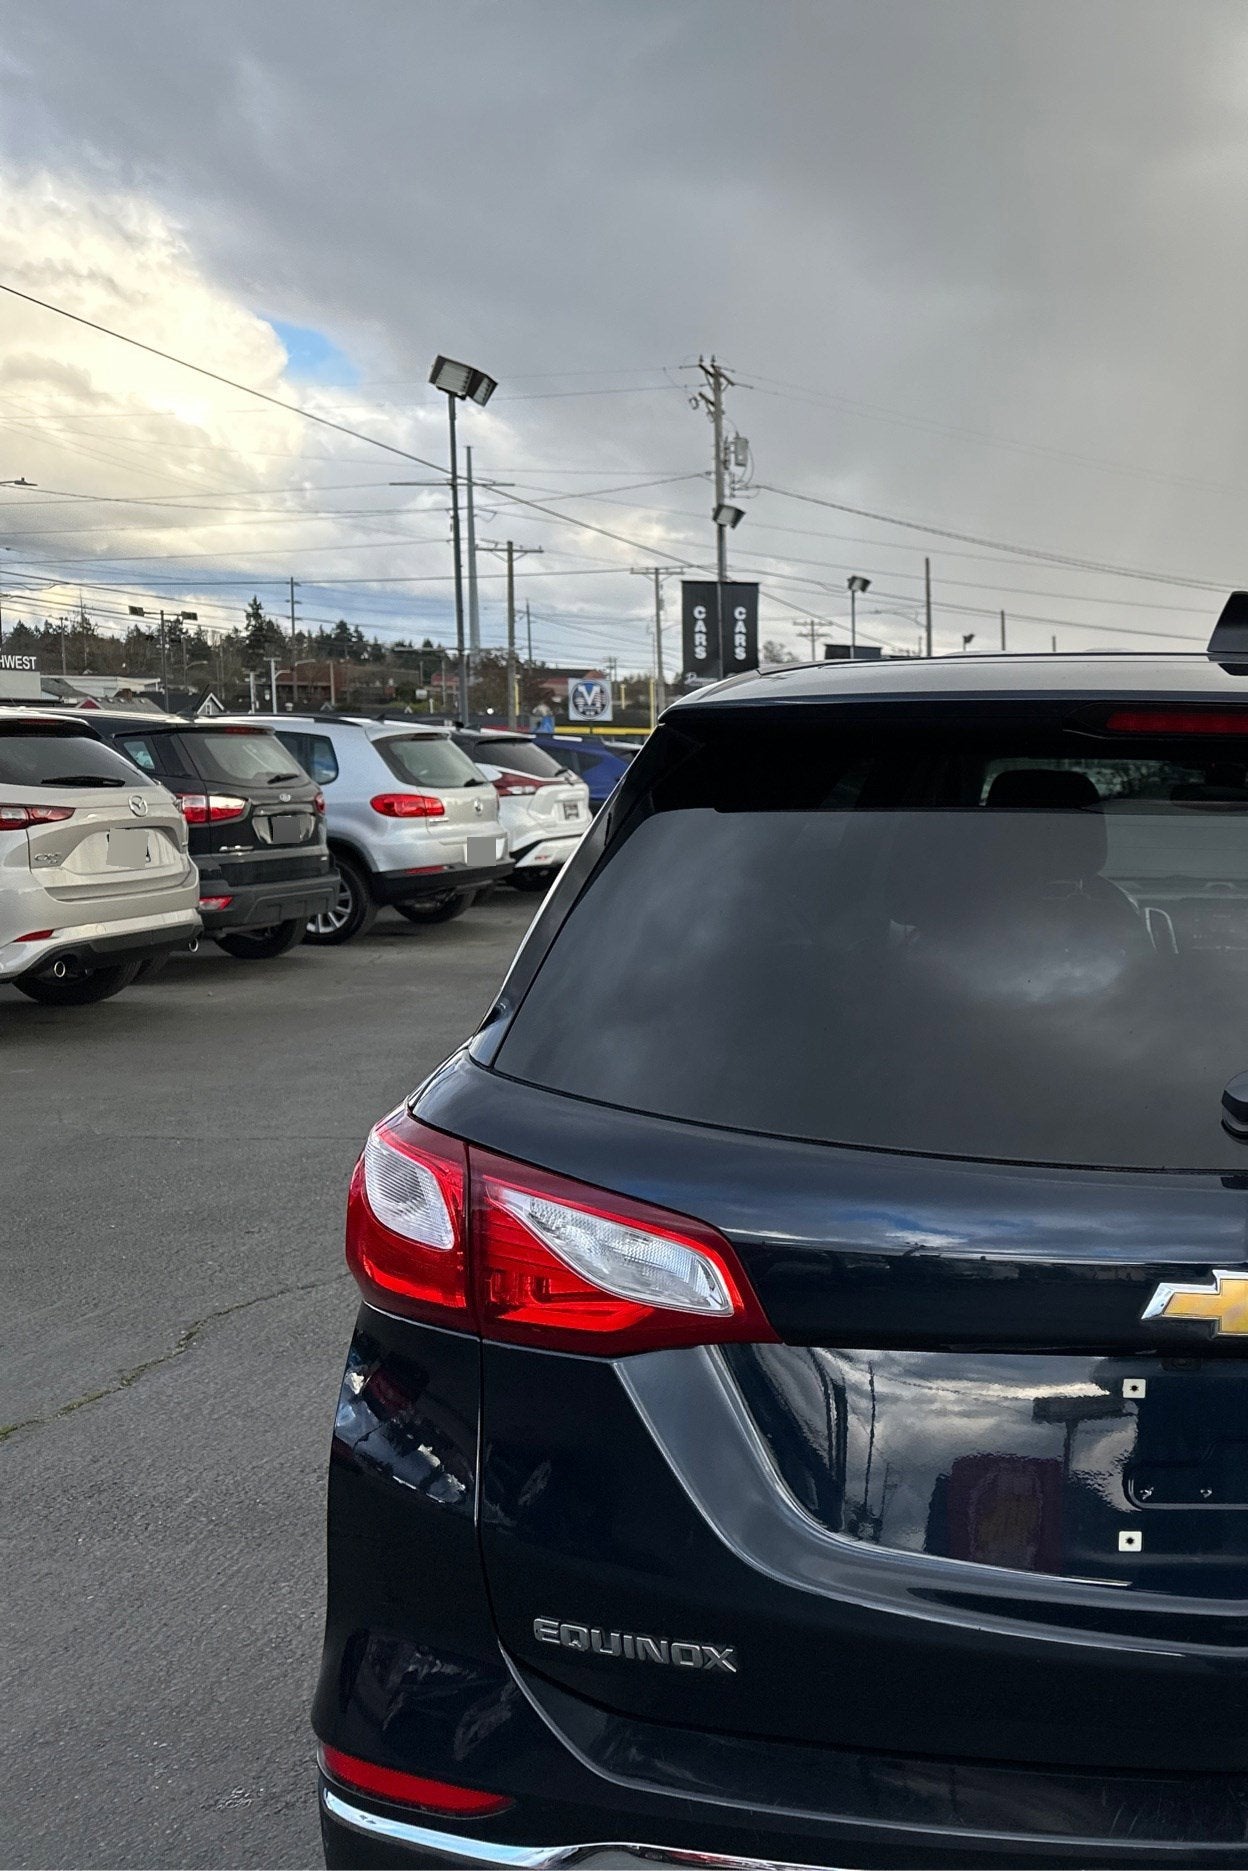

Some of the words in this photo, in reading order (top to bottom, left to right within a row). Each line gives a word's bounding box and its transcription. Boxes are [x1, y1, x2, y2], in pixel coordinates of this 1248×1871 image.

[693, 605, 707, 660] CARS
[734, 606, 747, 660] CARS
[533, 1616, 737, 1673] EQUINOX
